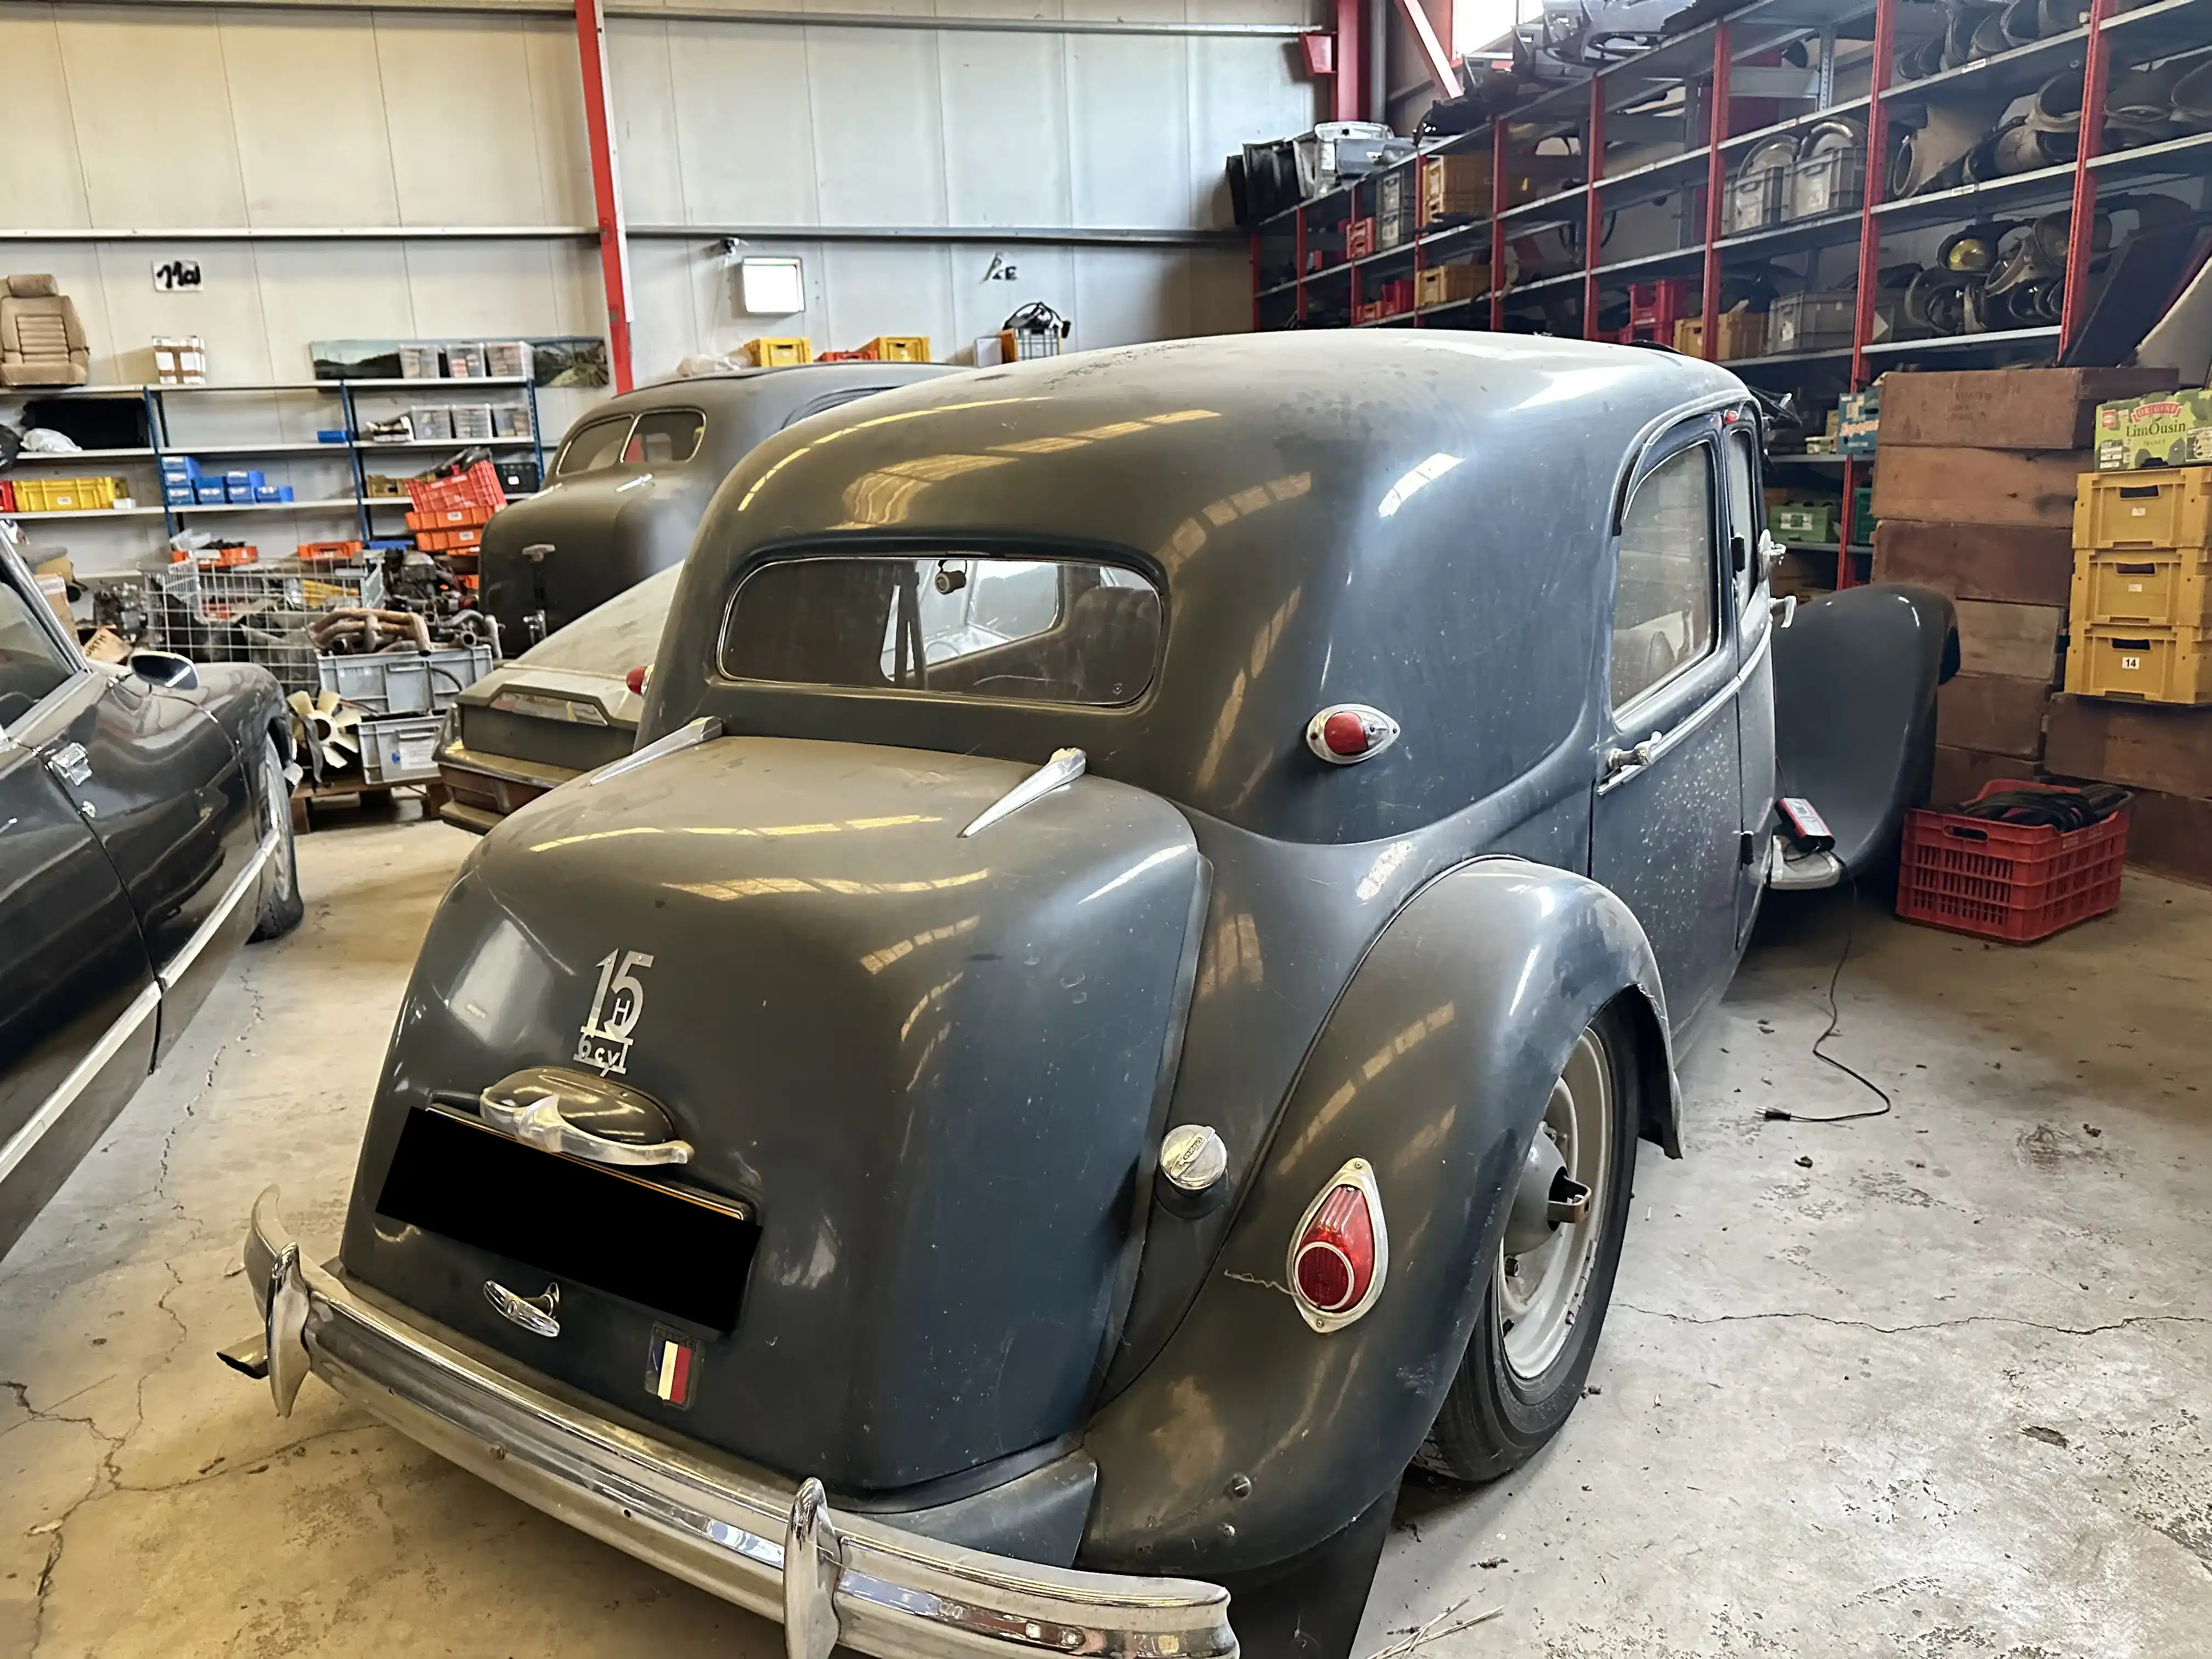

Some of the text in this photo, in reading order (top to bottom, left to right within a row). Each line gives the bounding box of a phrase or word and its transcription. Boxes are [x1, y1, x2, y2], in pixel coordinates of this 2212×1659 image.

[2125, 658, 2136, 667] 14
[586, 948, 654, 1038] 15
[612, 997, 631, 1027] H
